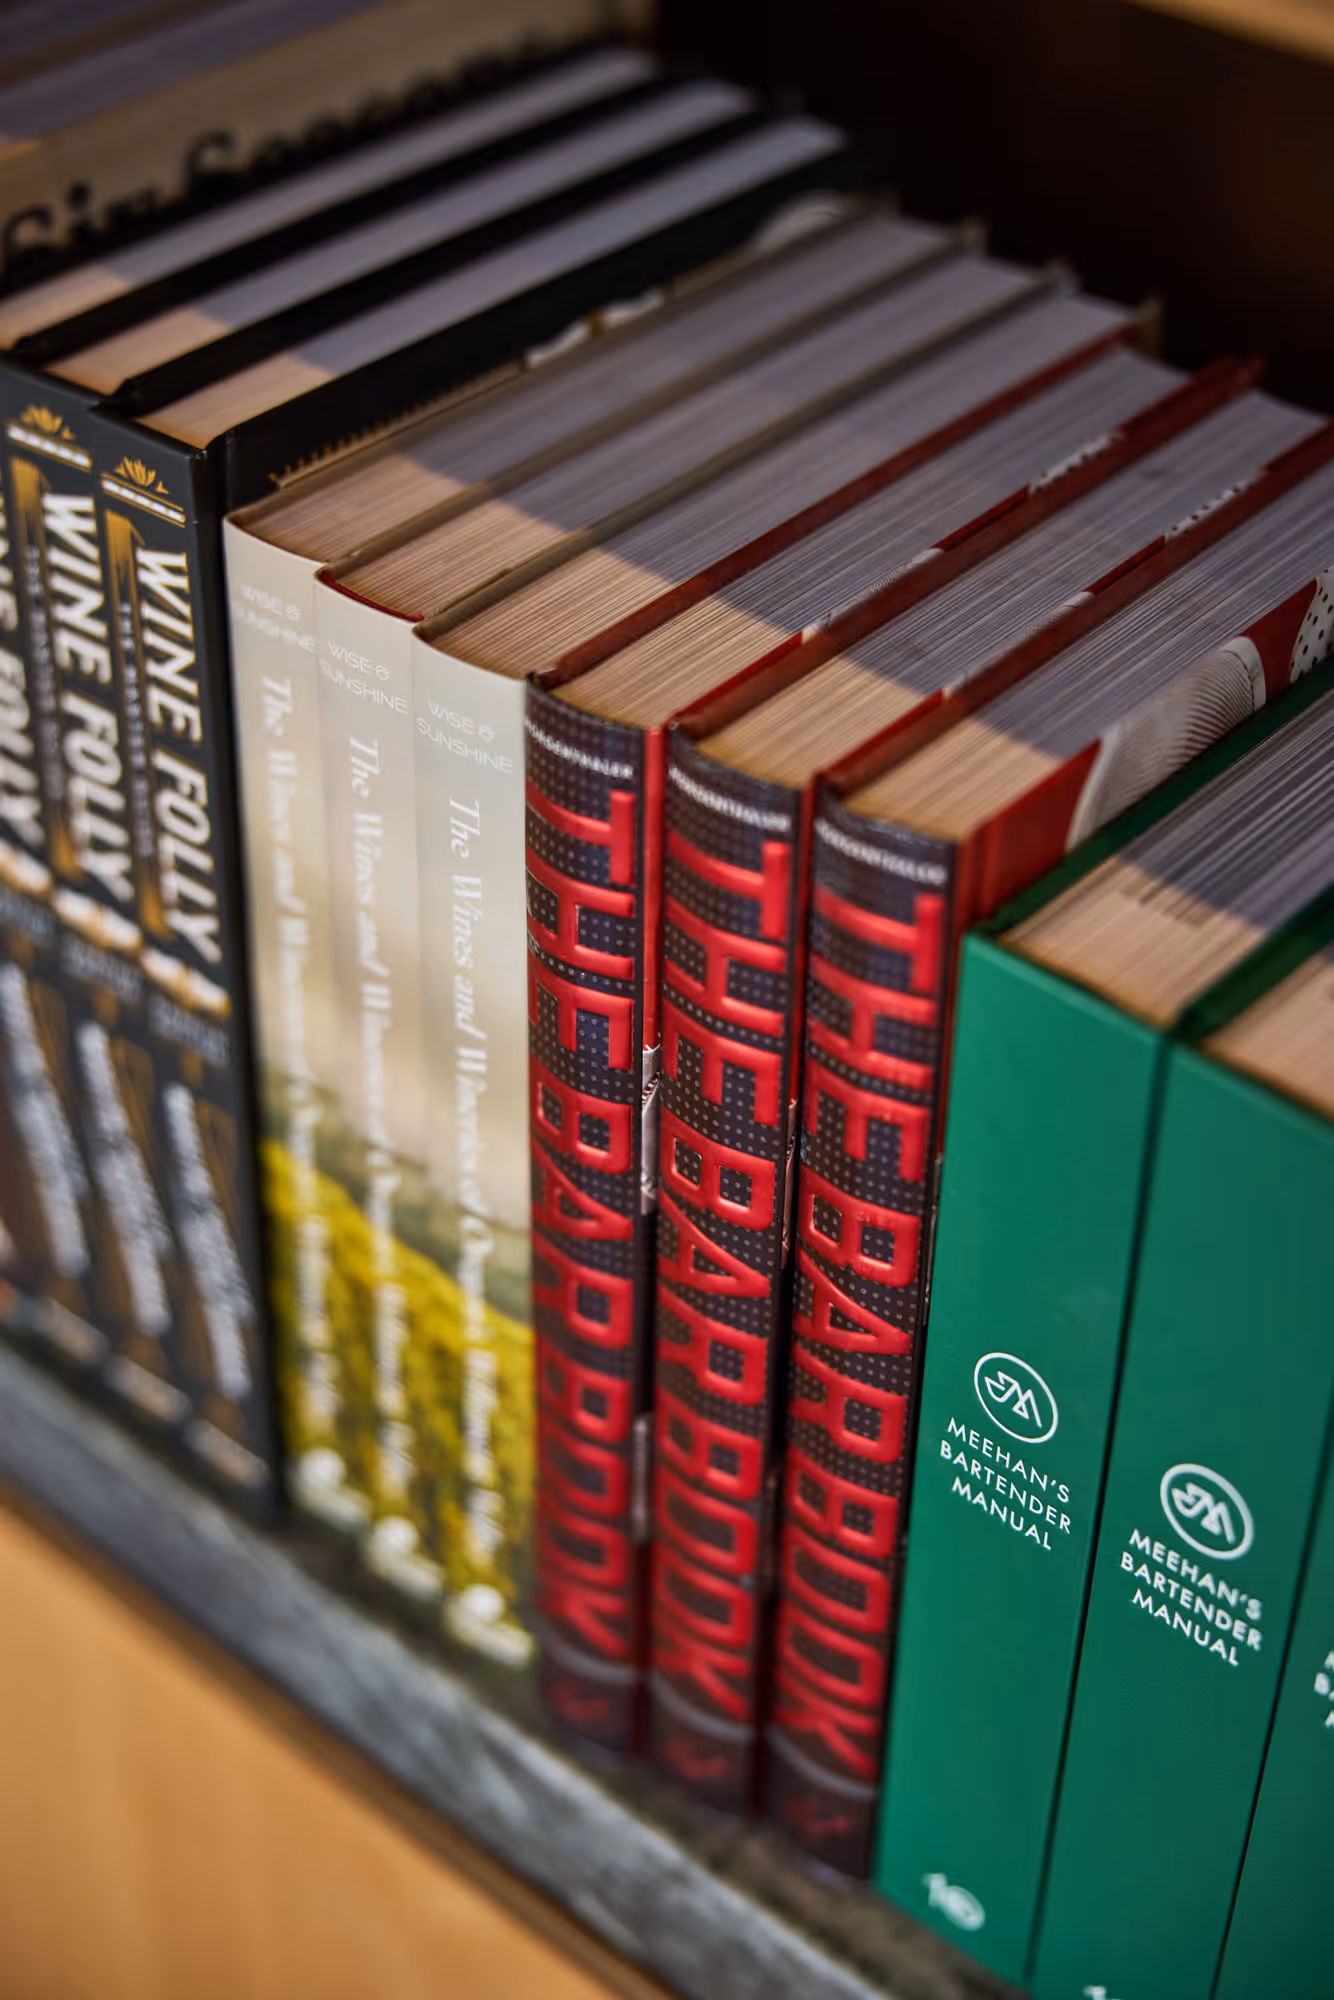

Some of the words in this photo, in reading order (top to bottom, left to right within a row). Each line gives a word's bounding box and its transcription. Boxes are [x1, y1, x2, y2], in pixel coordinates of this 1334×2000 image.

[43, 494, 111, 684] WINE
[136, 547, 203, 742] WINE
[318, 657, 409, 715] SUNSHINE
[327, 640, 373, 677] WISE
[416, 717, 514, 775] SUNSHINE
[426, 696, 476, 738] WISE
[61, 690, 135, 903] FOLLY
[348, 736, 382, 798] The
[152, 748, 222, 963] FOLLY
[448, 796, 482, 860] The
[450, 874, 484, 969] Wines
[526, 778, 635, 1071] THE
[453, 973, 488, 1042] and
[664, 828, 790, 1128] THE
[805, 888, 944, 1183] THE
[940, 1439, 1071, 1534] BARTENDER
[947, 1416, 1070, 1503] MEEHAN'S
[952, 1475, 1052, 1551] MANUAL
[1120, 1550, 1263, 1652] BARTENDER
[1128, 1527, 1263, 1621] MEEHAN'S
[1131, 1587, 1240, 1667] MANUAL
